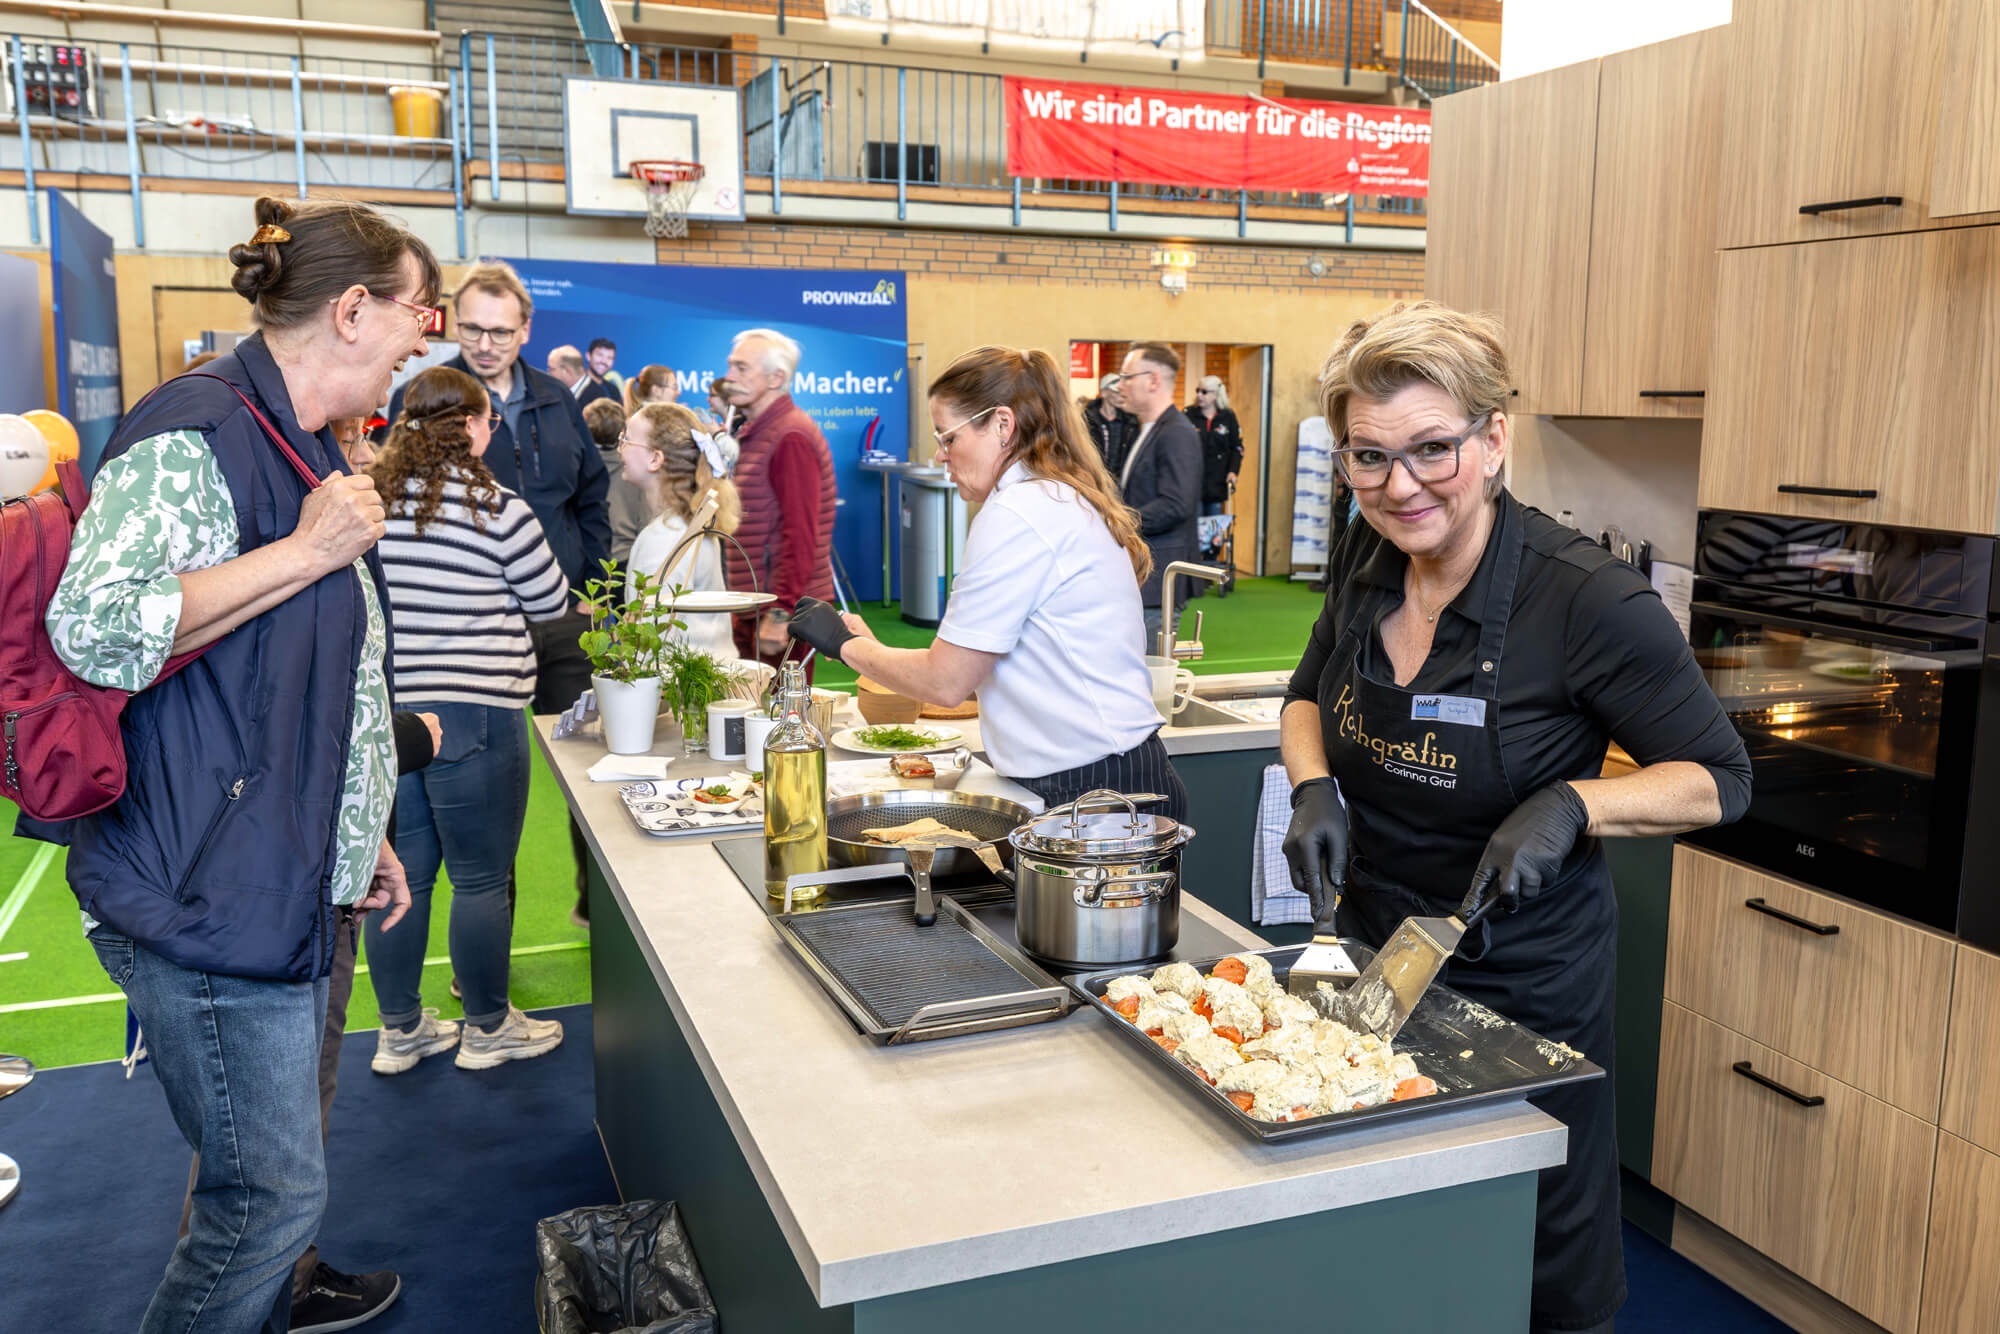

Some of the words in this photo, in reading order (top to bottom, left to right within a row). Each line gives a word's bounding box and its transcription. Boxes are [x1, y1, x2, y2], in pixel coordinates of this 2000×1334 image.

[1022, 88, 1076, 121] Wir
[1082, 94, 1142, 127] sind
[1148, 99, 1251, 133] Partner
[1256, 105, 1296, 136] für
[1300, 108, 1341, 139] die
[1346, 112, 1431, 150] Region
[802, 290, 892, 306] PROVINZIAL
[795, 370, 893, 394] Macher.
[824, 406, 853, 416] Leben
[856, 405, 879, 416] lebt:
[1384, 763, 1427, 783] Corinna
[1430, 776, 1457, 790] Graf
[1796, 843, 1815, 857] AEG
